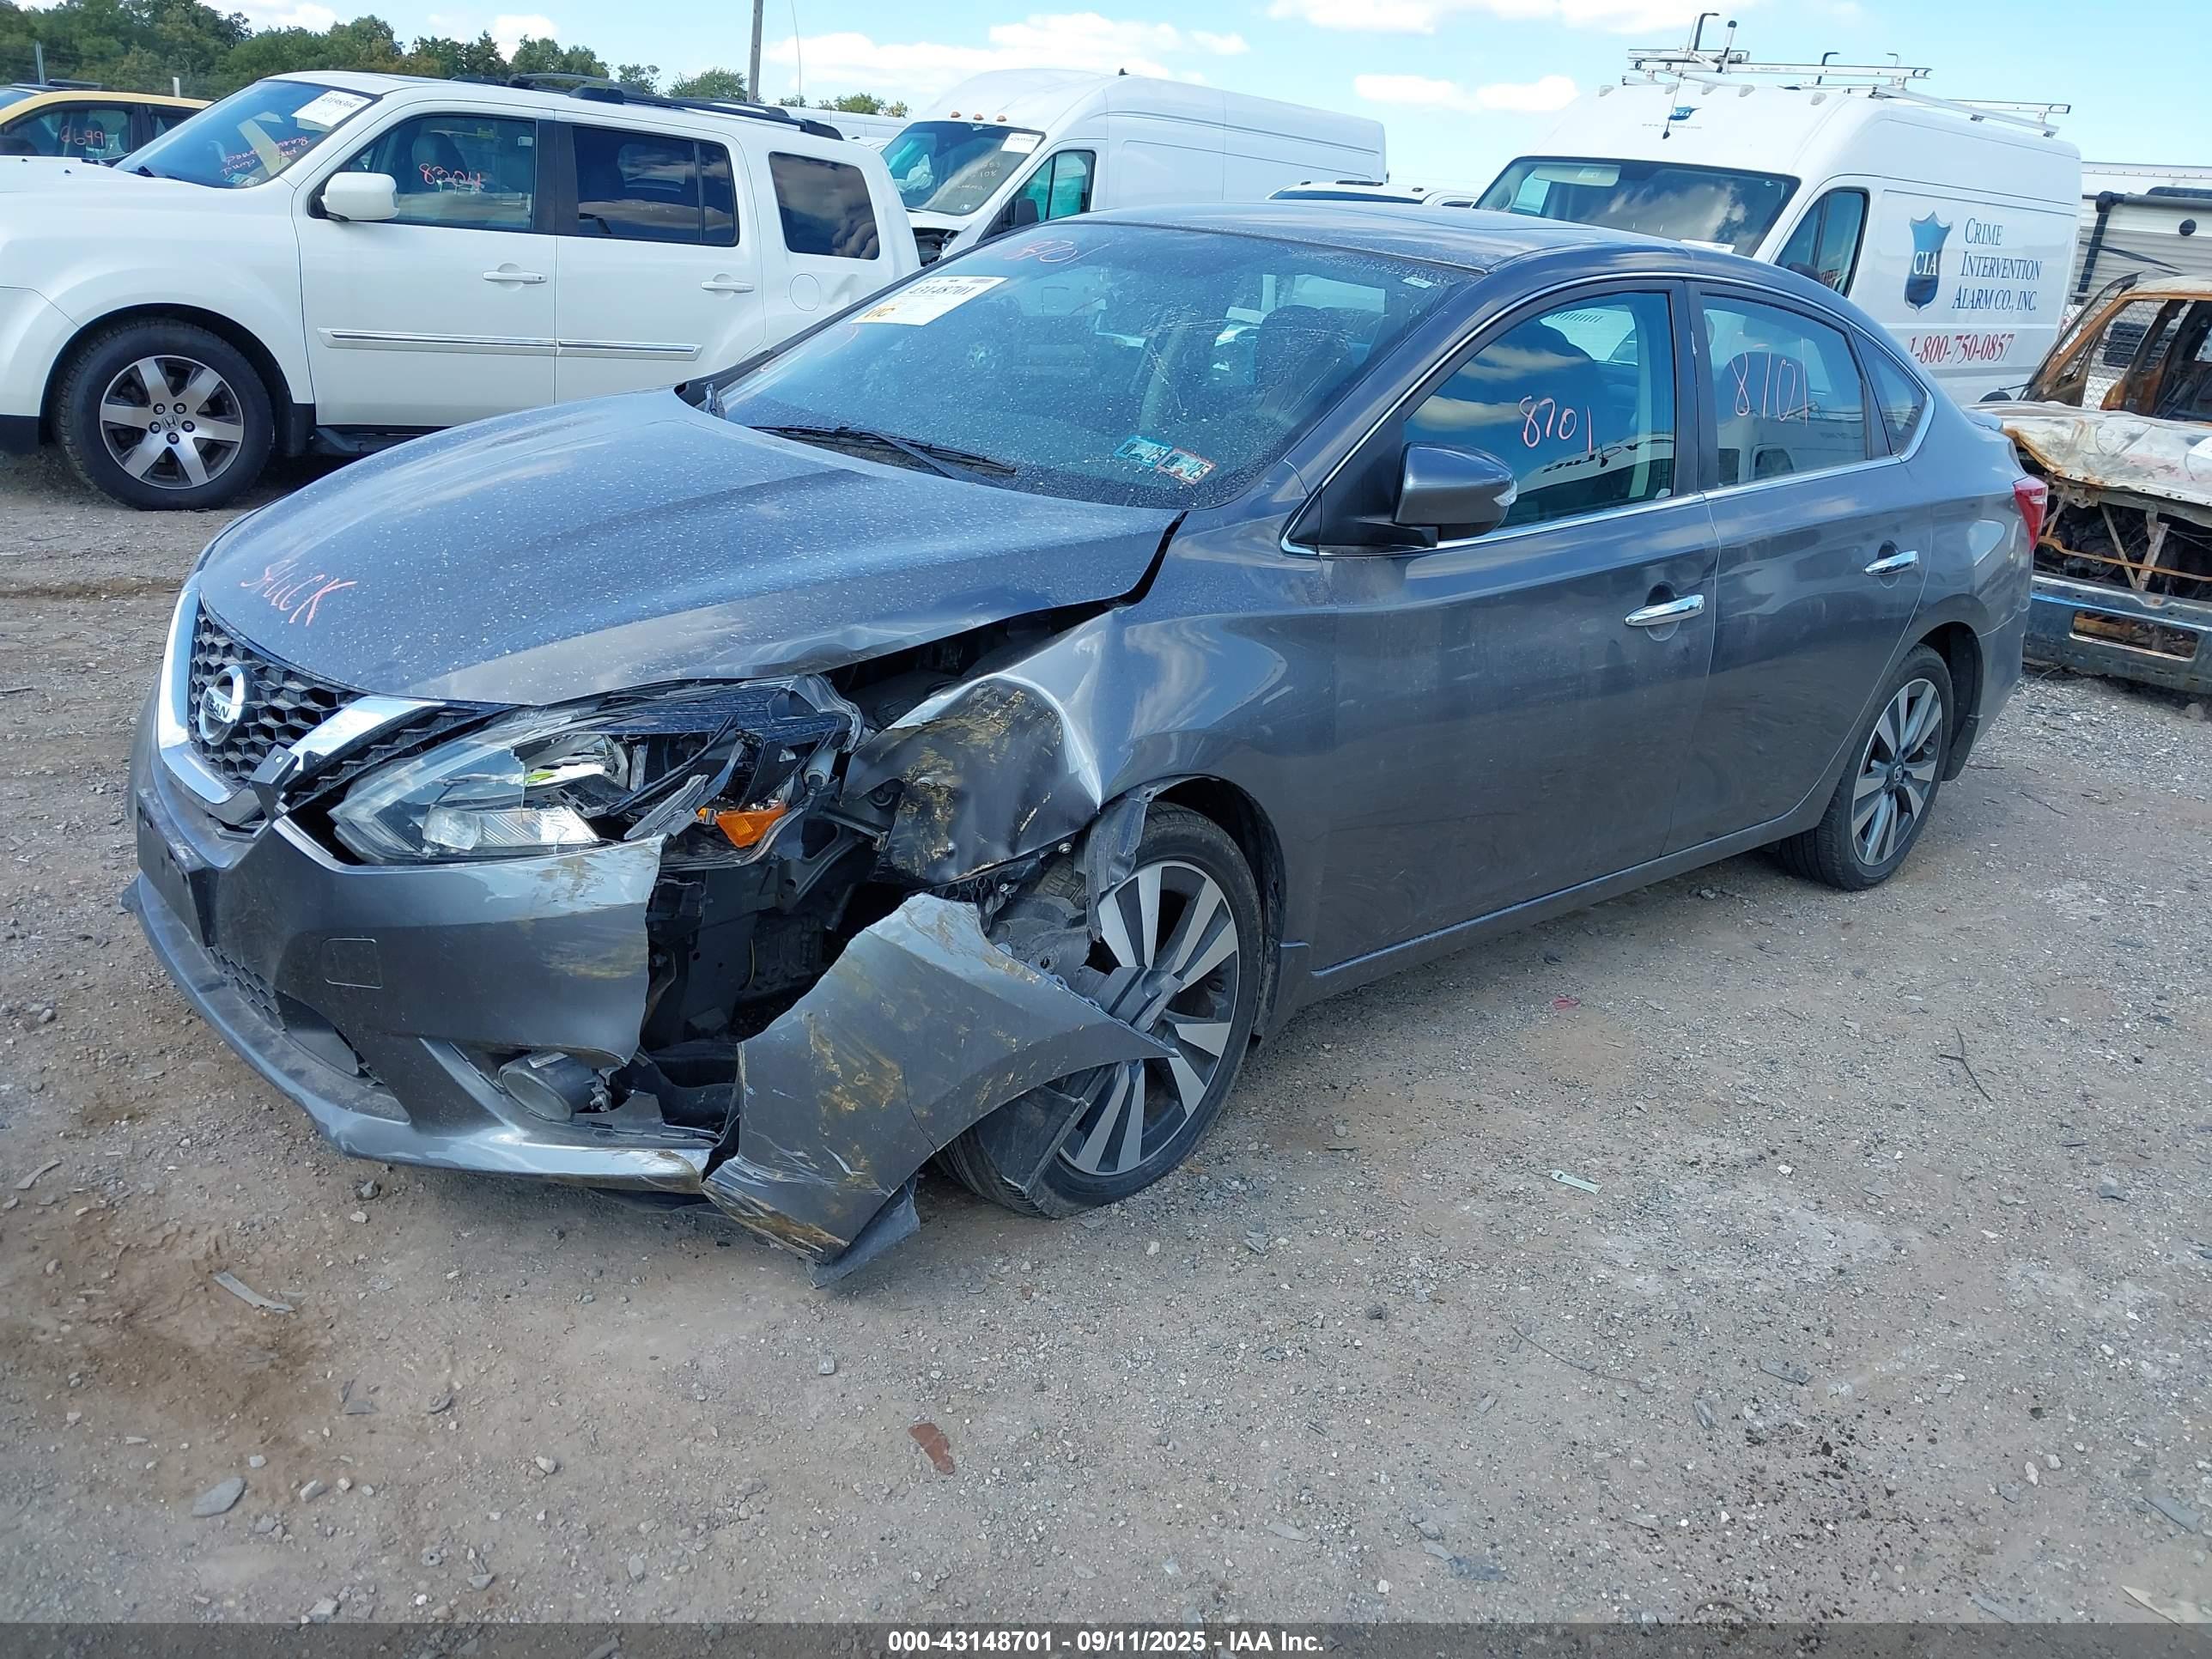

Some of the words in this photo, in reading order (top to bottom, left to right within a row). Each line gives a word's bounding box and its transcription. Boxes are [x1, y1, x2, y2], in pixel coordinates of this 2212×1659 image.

[1964, 216, 2003, 246] CRIME
[1913, 252, 1938, 276] CIA
[1959, 251, 2043, 281] INTERVENTION
[1951, 284, 1994, 310] ALARM
[2015, 290, 2039, 312] INC.
[1910, 333, 2015, 364] 1-800-750-0857
[1519, 395, 1593, 454] 8701
